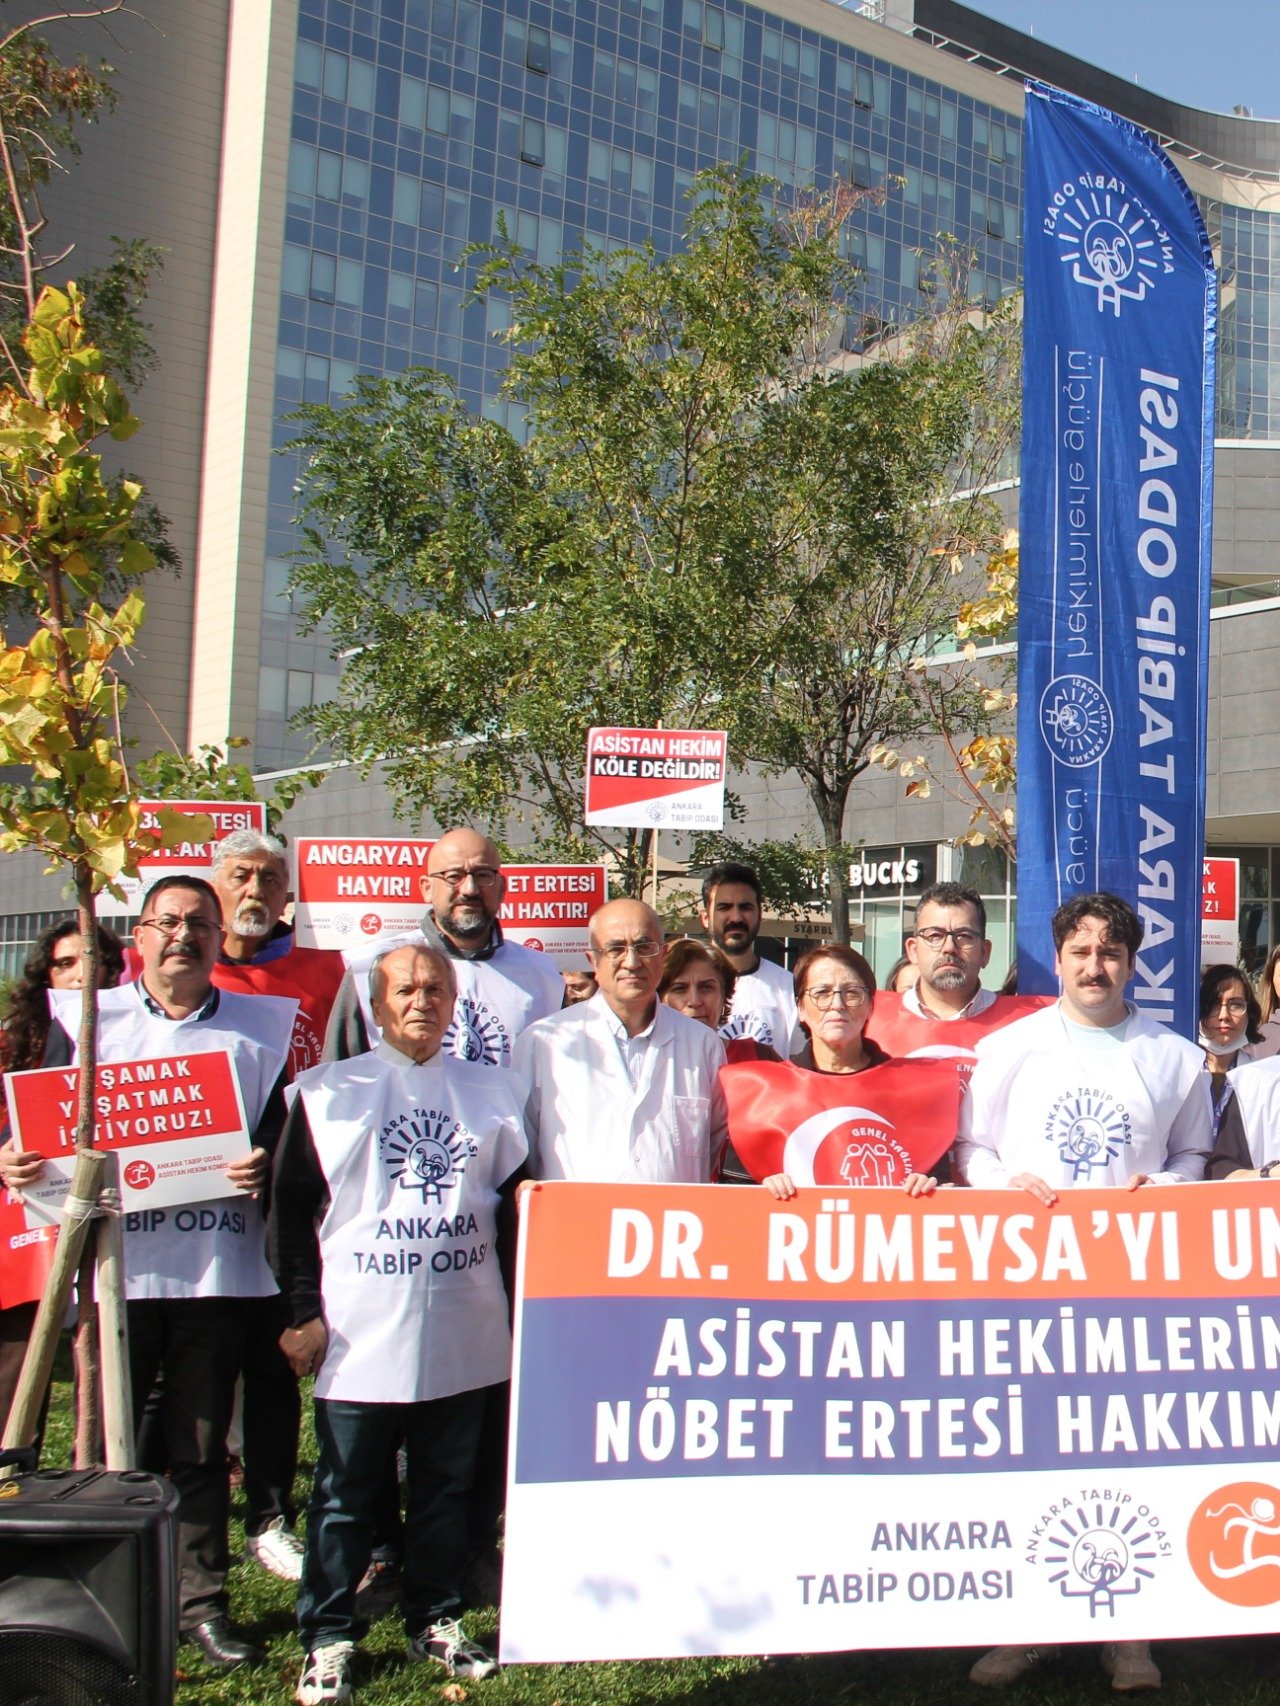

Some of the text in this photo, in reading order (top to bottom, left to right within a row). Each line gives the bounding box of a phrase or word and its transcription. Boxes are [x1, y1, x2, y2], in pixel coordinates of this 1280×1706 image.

[593, 733, 722, 757] ASİSTAN HEKİM
[594, 756, 721, 780] KÖLE DEĞİLDİR!
[306, 844, 428, 867] ANGARYAY
[337, 875, 411, 897] HAYIR!
[534, 872, 596, 892] ERTESİ
[518, 902, 588, 919] HAKTIR!
[491, 1016, 510, 1053] ODASI
[62, 1060, 192, 1092] YŞAMAK
[58, 1083, 204, 1119] YŞATMAK
[380, 1109, 478, 1160] KARA TABİP ODASI
[851, 1127, 888, 1142] GENEL
[1116, 1104, 1132, 1145] ODASI
[157, 1160, 184, 1169] ANKARA
[175, 1209, 246, 1235] ODASI
[375, 1213, 479, 1240] ANKARA
[10, 1228, 50, 1249] GENEL
[607, 1207, 728, 1281] DR.
[767, 1198, 1181, 1284] RÜMEYSA'YI
[354, 1243, 488, 1276] TABİP ODASI
[653, 1307, 905, 1379] ASİSTAN
[594, 1386, 793, 1464] NÖBET
[824, 1384, 1024, 1460] ERTESİ
[871, 1520, 1013, 1552] ANKARA
[1025, 1488, 1173, 1565] ANKARA TABİP ODASI
[797, 1567, 1014, 1605] TABİP ODASI
